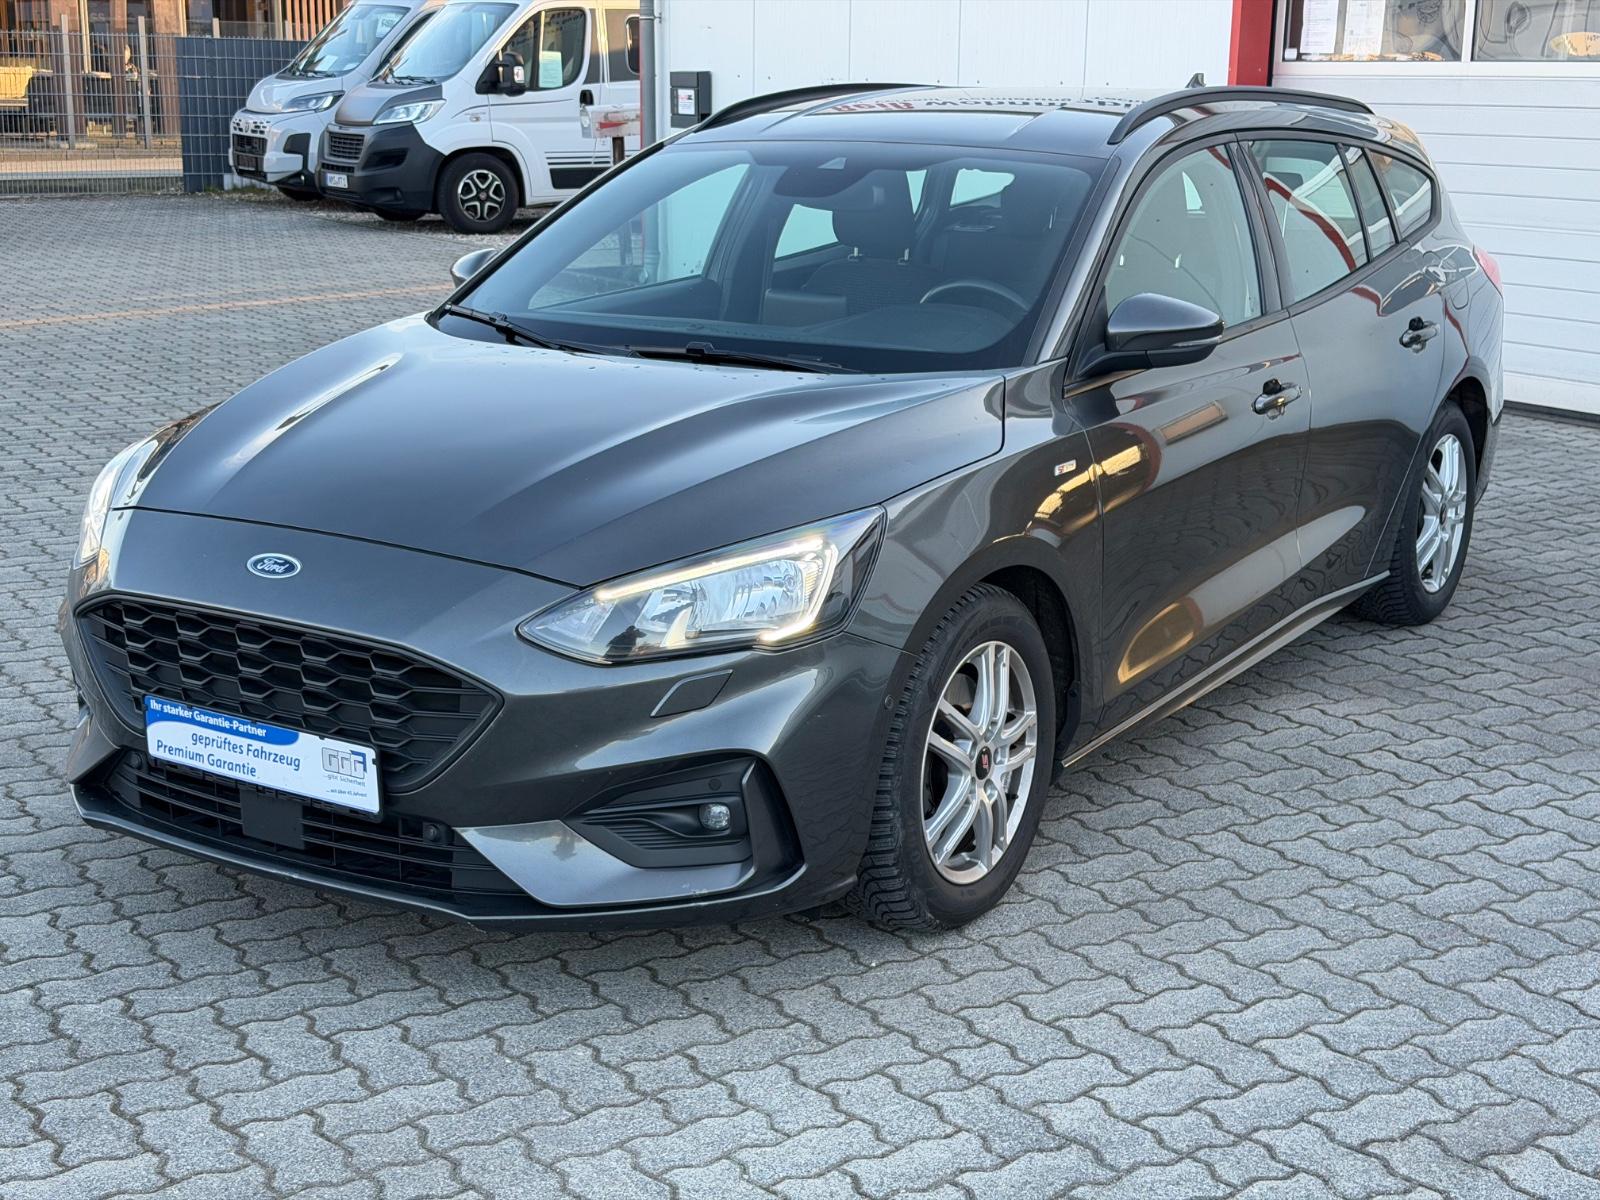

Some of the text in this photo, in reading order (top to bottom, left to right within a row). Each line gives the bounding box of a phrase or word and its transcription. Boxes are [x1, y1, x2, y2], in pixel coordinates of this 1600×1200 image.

[150, 699, 267, 737] Ihr starker Garantie-Partner
[156, 739, 257, 777] Premium Garantie
[191, 732, 301, 772] geprüftes Fahrzeug
